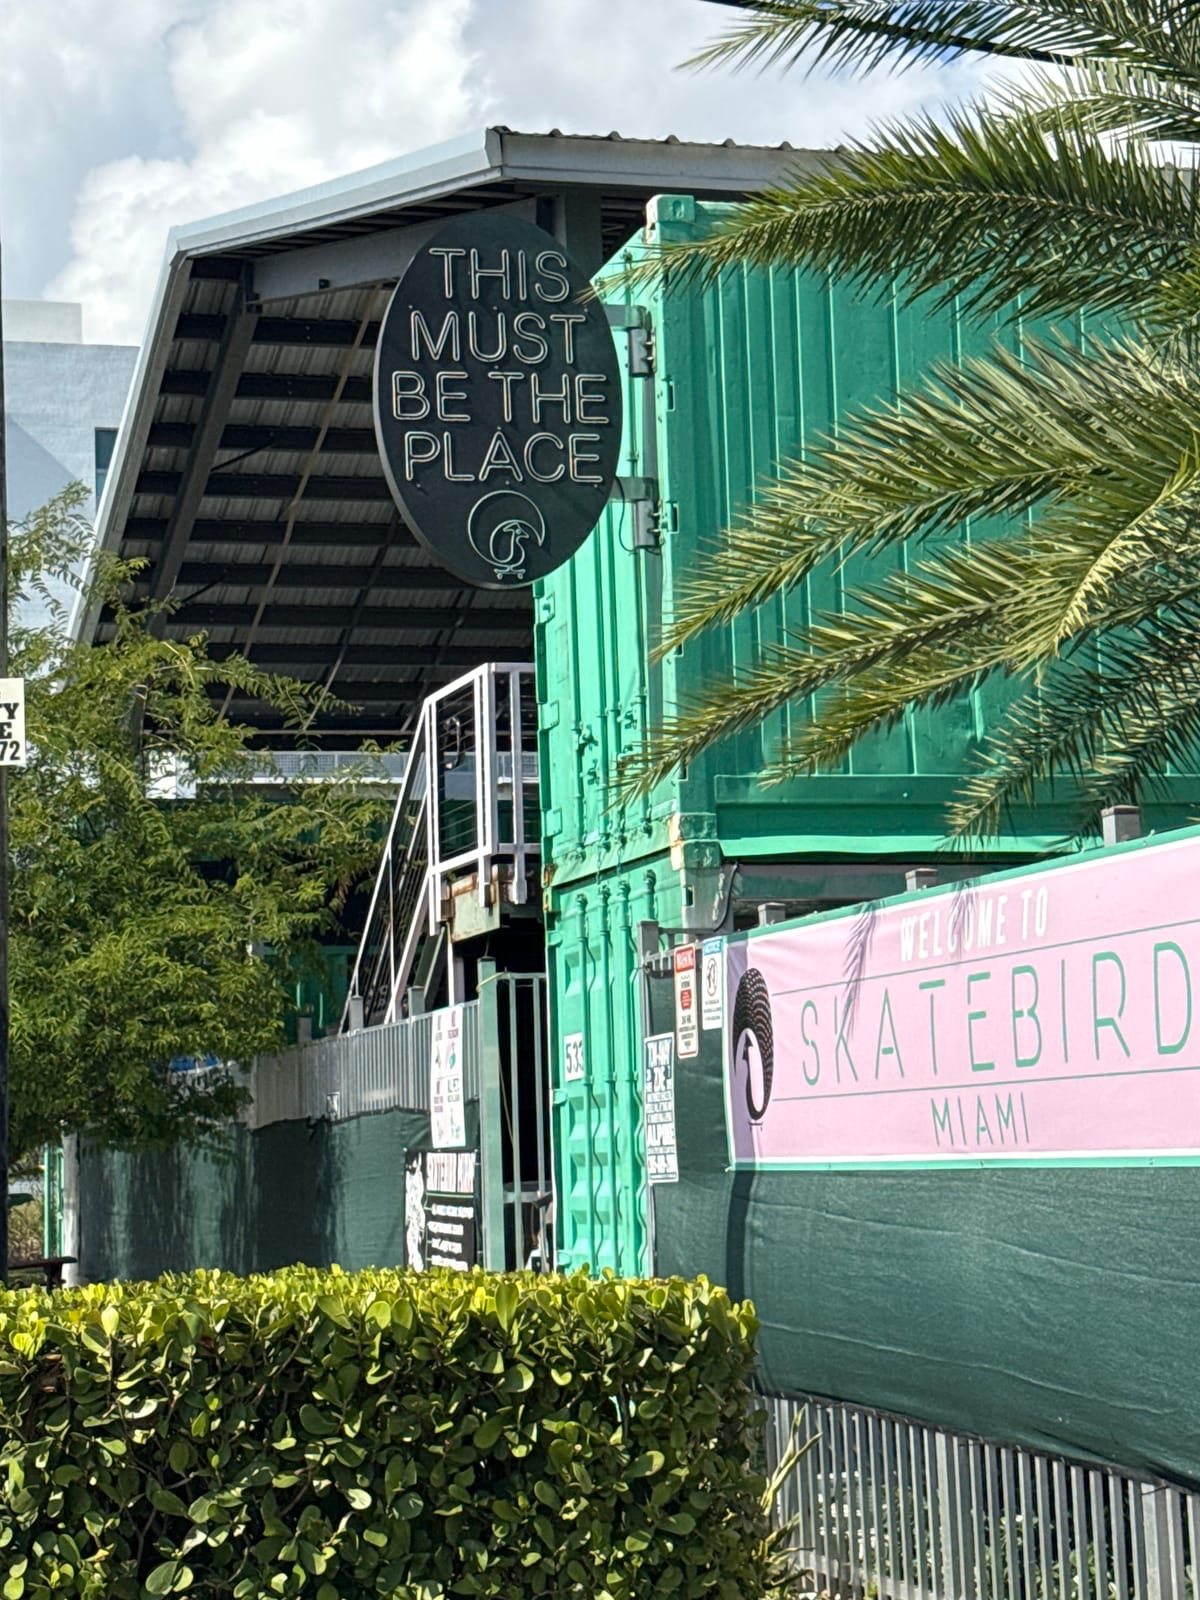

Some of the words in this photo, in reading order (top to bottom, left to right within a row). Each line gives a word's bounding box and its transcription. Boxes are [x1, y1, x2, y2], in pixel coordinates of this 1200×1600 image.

[428, 247, 570, 303] THIS
[410, 310, 586, 364] MUST
[391, 371, 472, 423] BE
[487, 371, 610, 424] THE
[404, 431, 604, 483] PLACE
[899, 895, 1007, 963] WELCOME
[1020, 885, 1048, 939] TO
[799, 940, 1193, 1087] SKATEBIRD
[930, 1090, 1031, 1147] MIAMI
